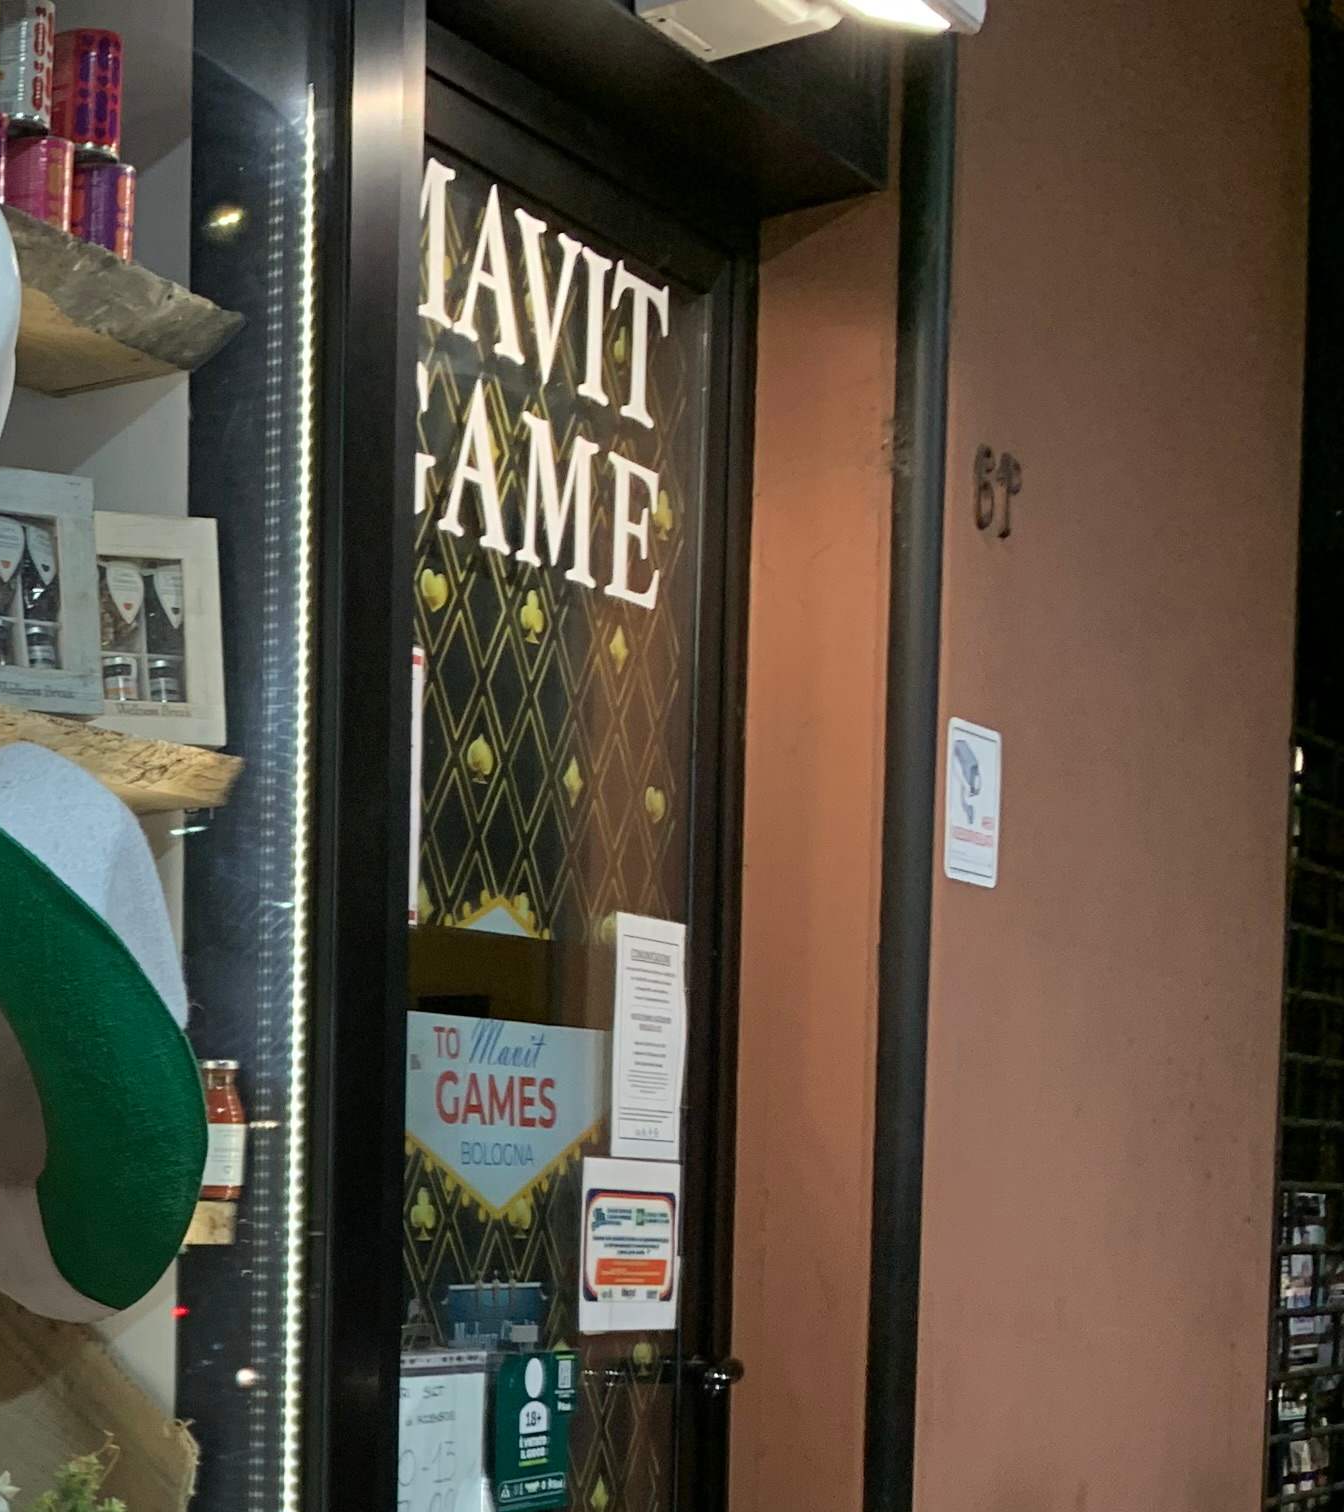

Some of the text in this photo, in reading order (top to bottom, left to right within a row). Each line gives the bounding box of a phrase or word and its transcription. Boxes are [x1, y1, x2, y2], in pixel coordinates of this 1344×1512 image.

[414, 361, 660, 610] AME
[433, 1025, 461, 1060] TO
[435, 1069, 558, 1130] GAMES
[460, 1140, 534, 1167] BOLOGNA
